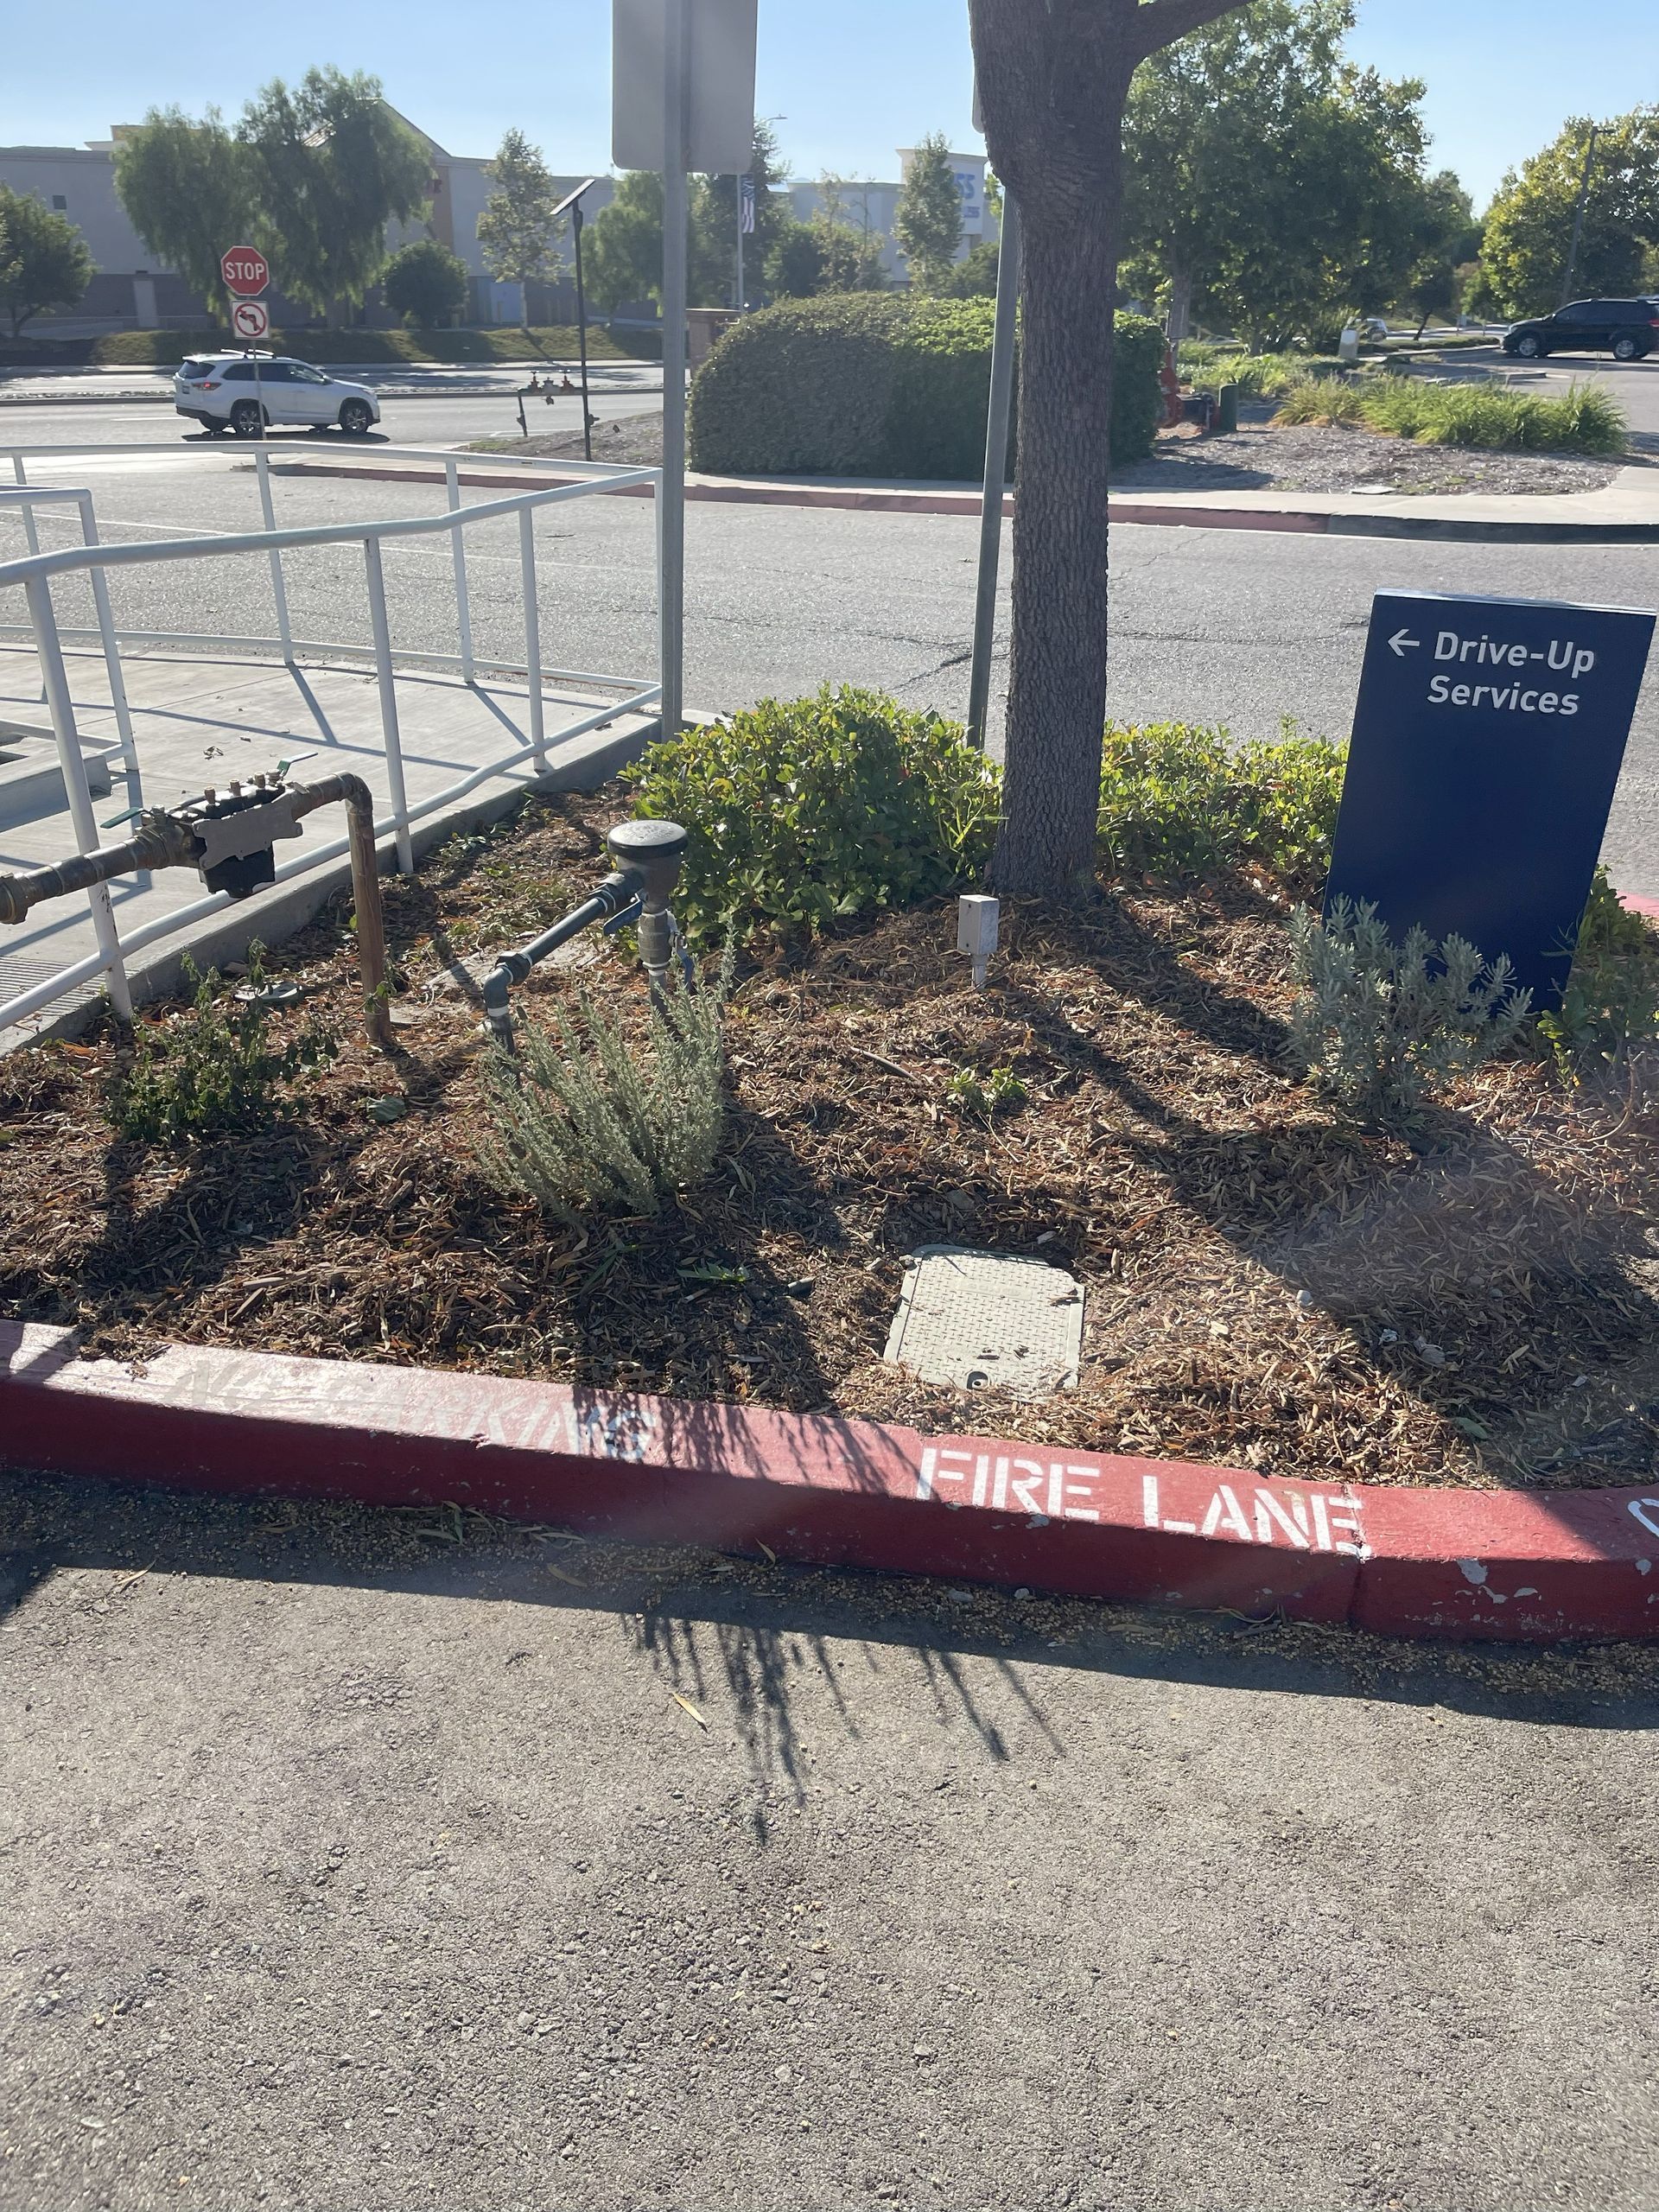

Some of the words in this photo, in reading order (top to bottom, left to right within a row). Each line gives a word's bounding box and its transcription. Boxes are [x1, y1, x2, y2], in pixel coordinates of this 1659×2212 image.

[226, 262, 265, 280] STOP
[1433, 632, 1595, 678] Drive-Up
[1427, 676, 1580, 715] Services
[915, 1447, 1100, 1522] FIRE
[1141, 1475, 1370, 1558] LANE
